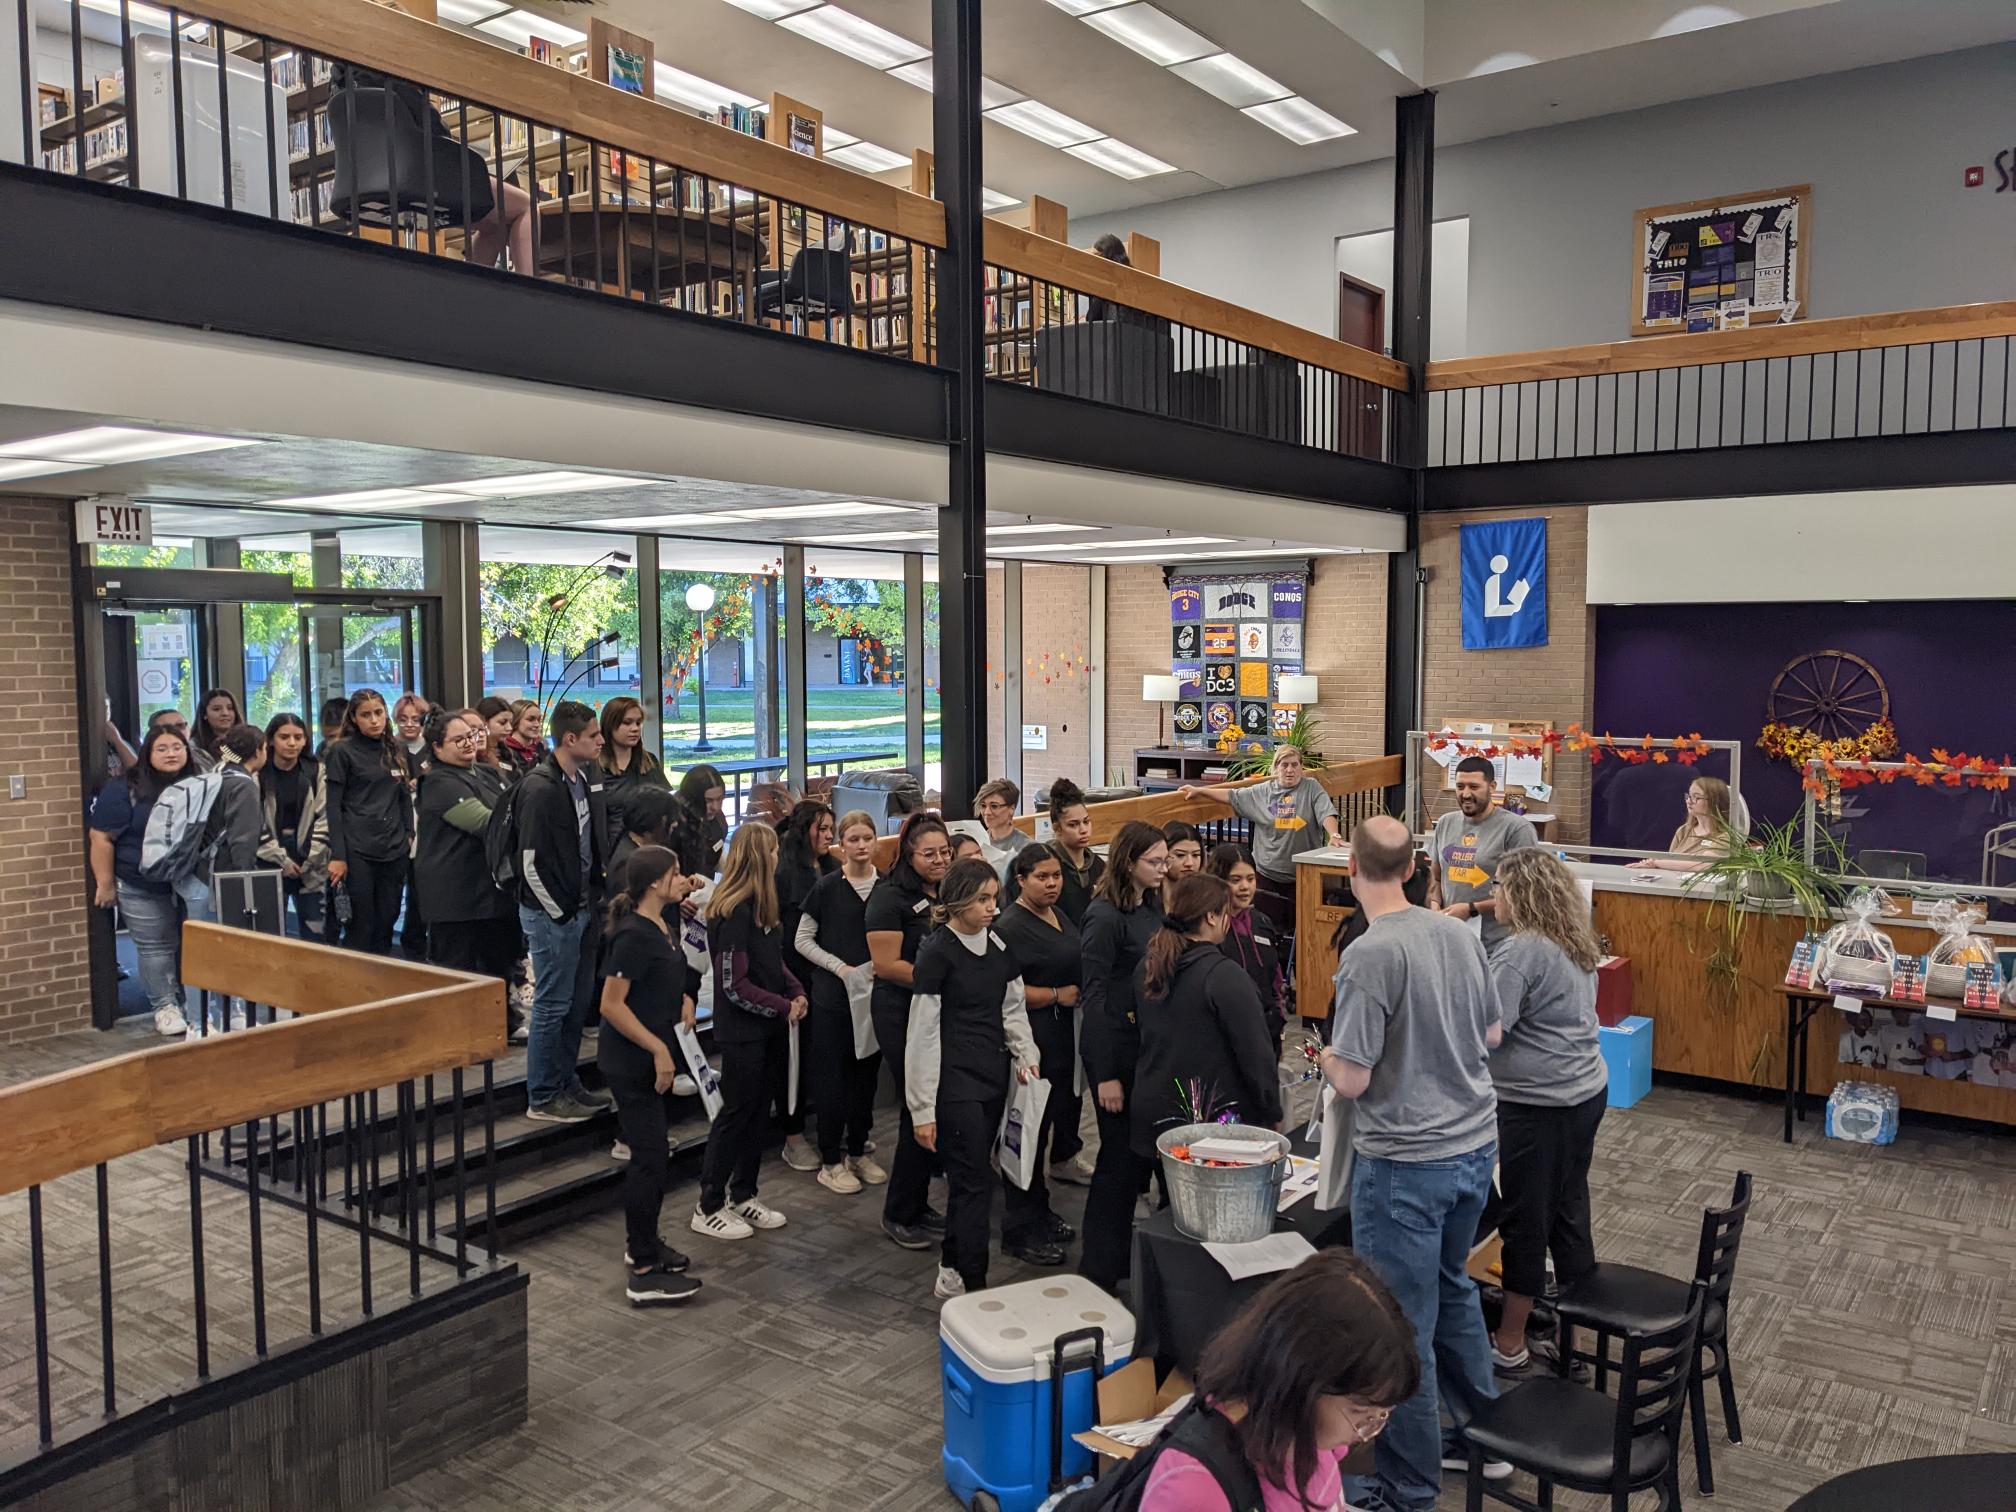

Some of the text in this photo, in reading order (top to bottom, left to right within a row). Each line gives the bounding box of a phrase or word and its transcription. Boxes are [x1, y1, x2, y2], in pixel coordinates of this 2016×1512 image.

[1656, 258, 1687, 269] TRIO
[96, 505, 142, 540] EXIT
[1187, 589, 1200, 600] CITY
[1273, 592, 1302, 603] CONQS
[1182, 598, 1190, 611] 3
[1212, 638, 1228, 649] 25
[1207, 668, 1216, 680] I
[1206, 679, 1236, 693] DC3
[1452, 851, 1474, 860] COLLEGE
